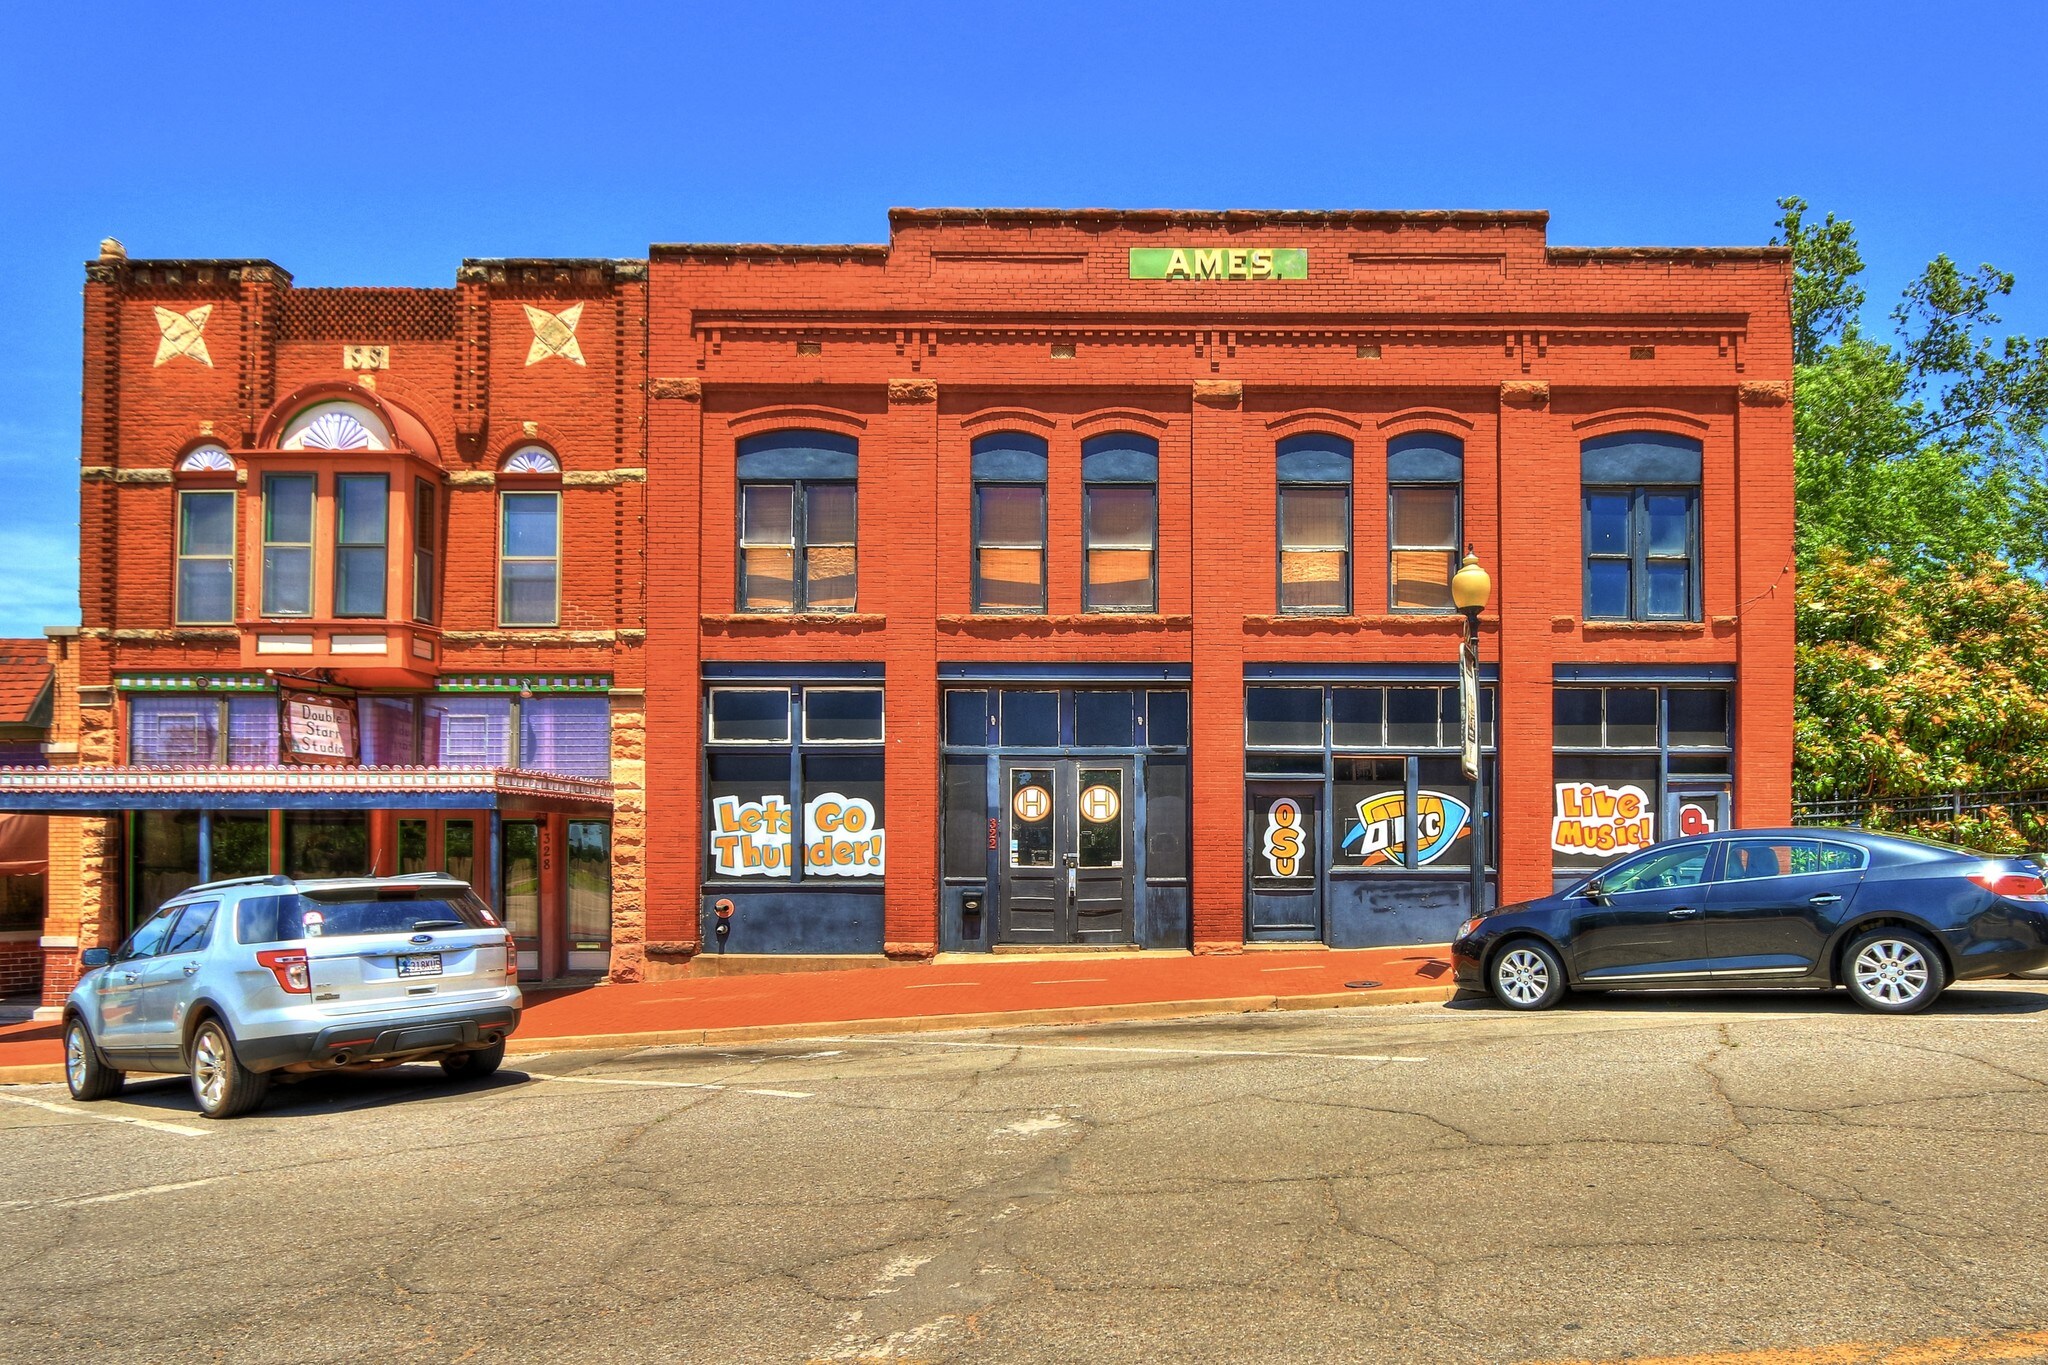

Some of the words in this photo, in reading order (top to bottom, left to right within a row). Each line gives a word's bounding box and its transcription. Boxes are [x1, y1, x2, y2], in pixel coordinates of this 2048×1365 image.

[302, 704, 342, 724] Double
[306, 721, 341, 738] Starr
[302, 736, 345, 754] Studio
[719, 801, 791, 834] Lets
[815, 802, 866, 833] Go
[1562, 787, 1641, 819] Live
[989, 818, 998, 850] 322
[1269, 803, 1300, 876] OSU
[1555, 818, 1651, 851] Music!
[543, 833, 551, 870] 328
